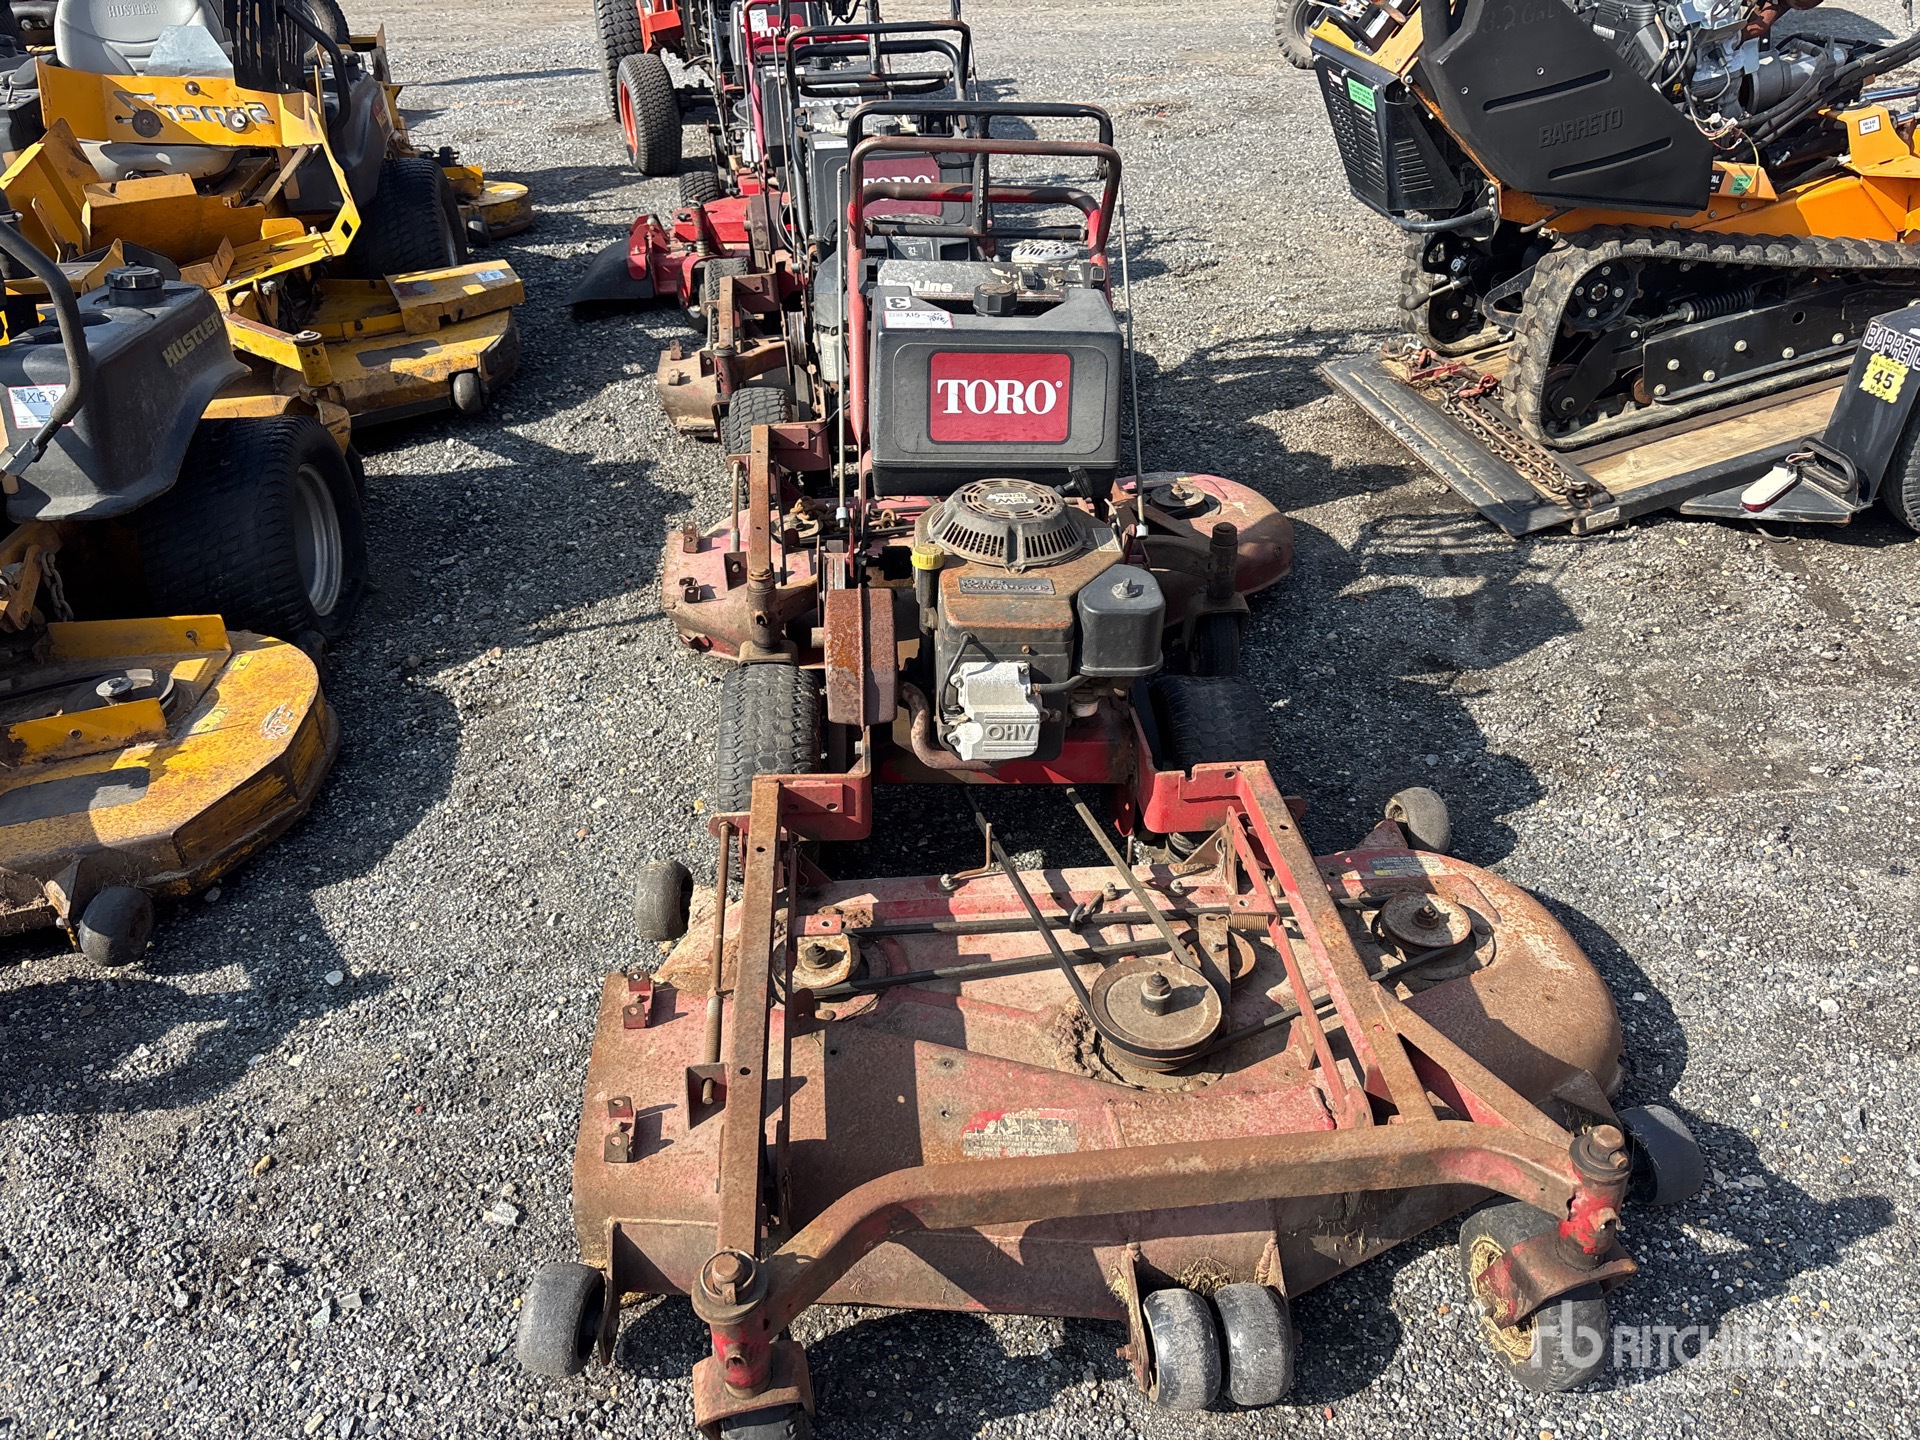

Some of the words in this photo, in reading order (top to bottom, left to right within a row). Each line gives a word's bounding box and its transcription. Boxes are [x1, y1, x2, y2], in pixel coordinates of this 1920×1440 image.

[107, 3, 159, 18] HUSTLER
[1539, 107, 1624, 148] BARRETO
[162, 311, 221, 368] HUSTLER
[1872, 369, 1895, 390] 45
[937, 379, 1058, 415] TORO
[986, 724, 1034, 741] OHV
